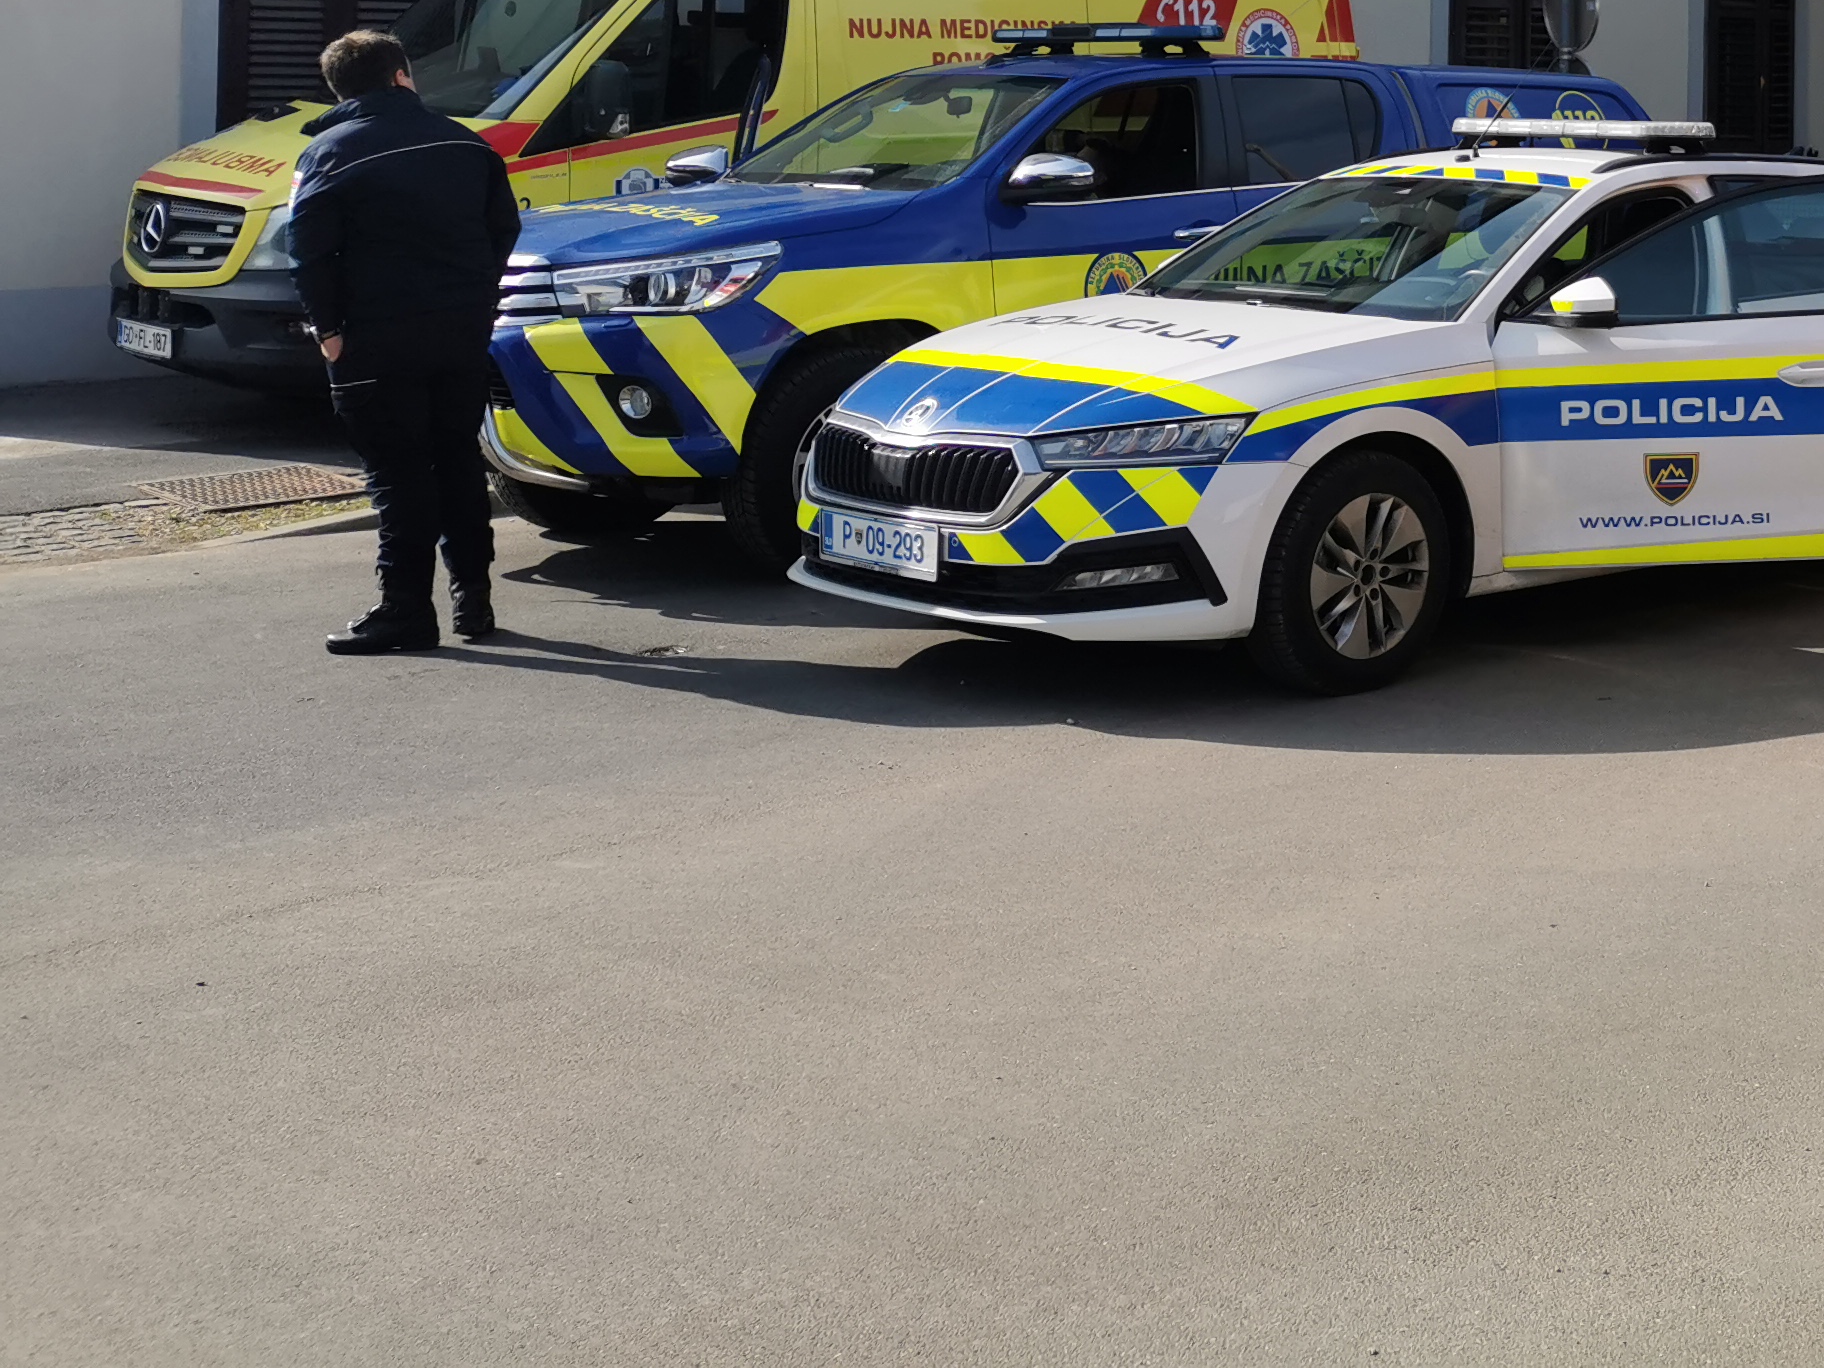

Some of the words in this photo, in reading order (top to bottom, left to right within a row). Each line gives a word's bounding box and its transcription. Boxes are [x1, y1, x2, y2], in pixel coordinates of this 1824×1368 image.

[848, 17, 932, 40] NUJNA
[1244, 9, 1286, 25] MEDICINSKA
[1088, 254, 1115, 286] REPUBLIKA
[123, 325, 133, 344] GO
[138, 329, 168, 352] FL-187
[987, 315, 1241, 350] POLICIJA
[1560, 395, 1785, 427] POLICIJA
[1578, 512, 1771, 529] WWW.POLICIJA.SI
[842, 519, 853, 549] P
[865, 524, 925, 564] 09-293
